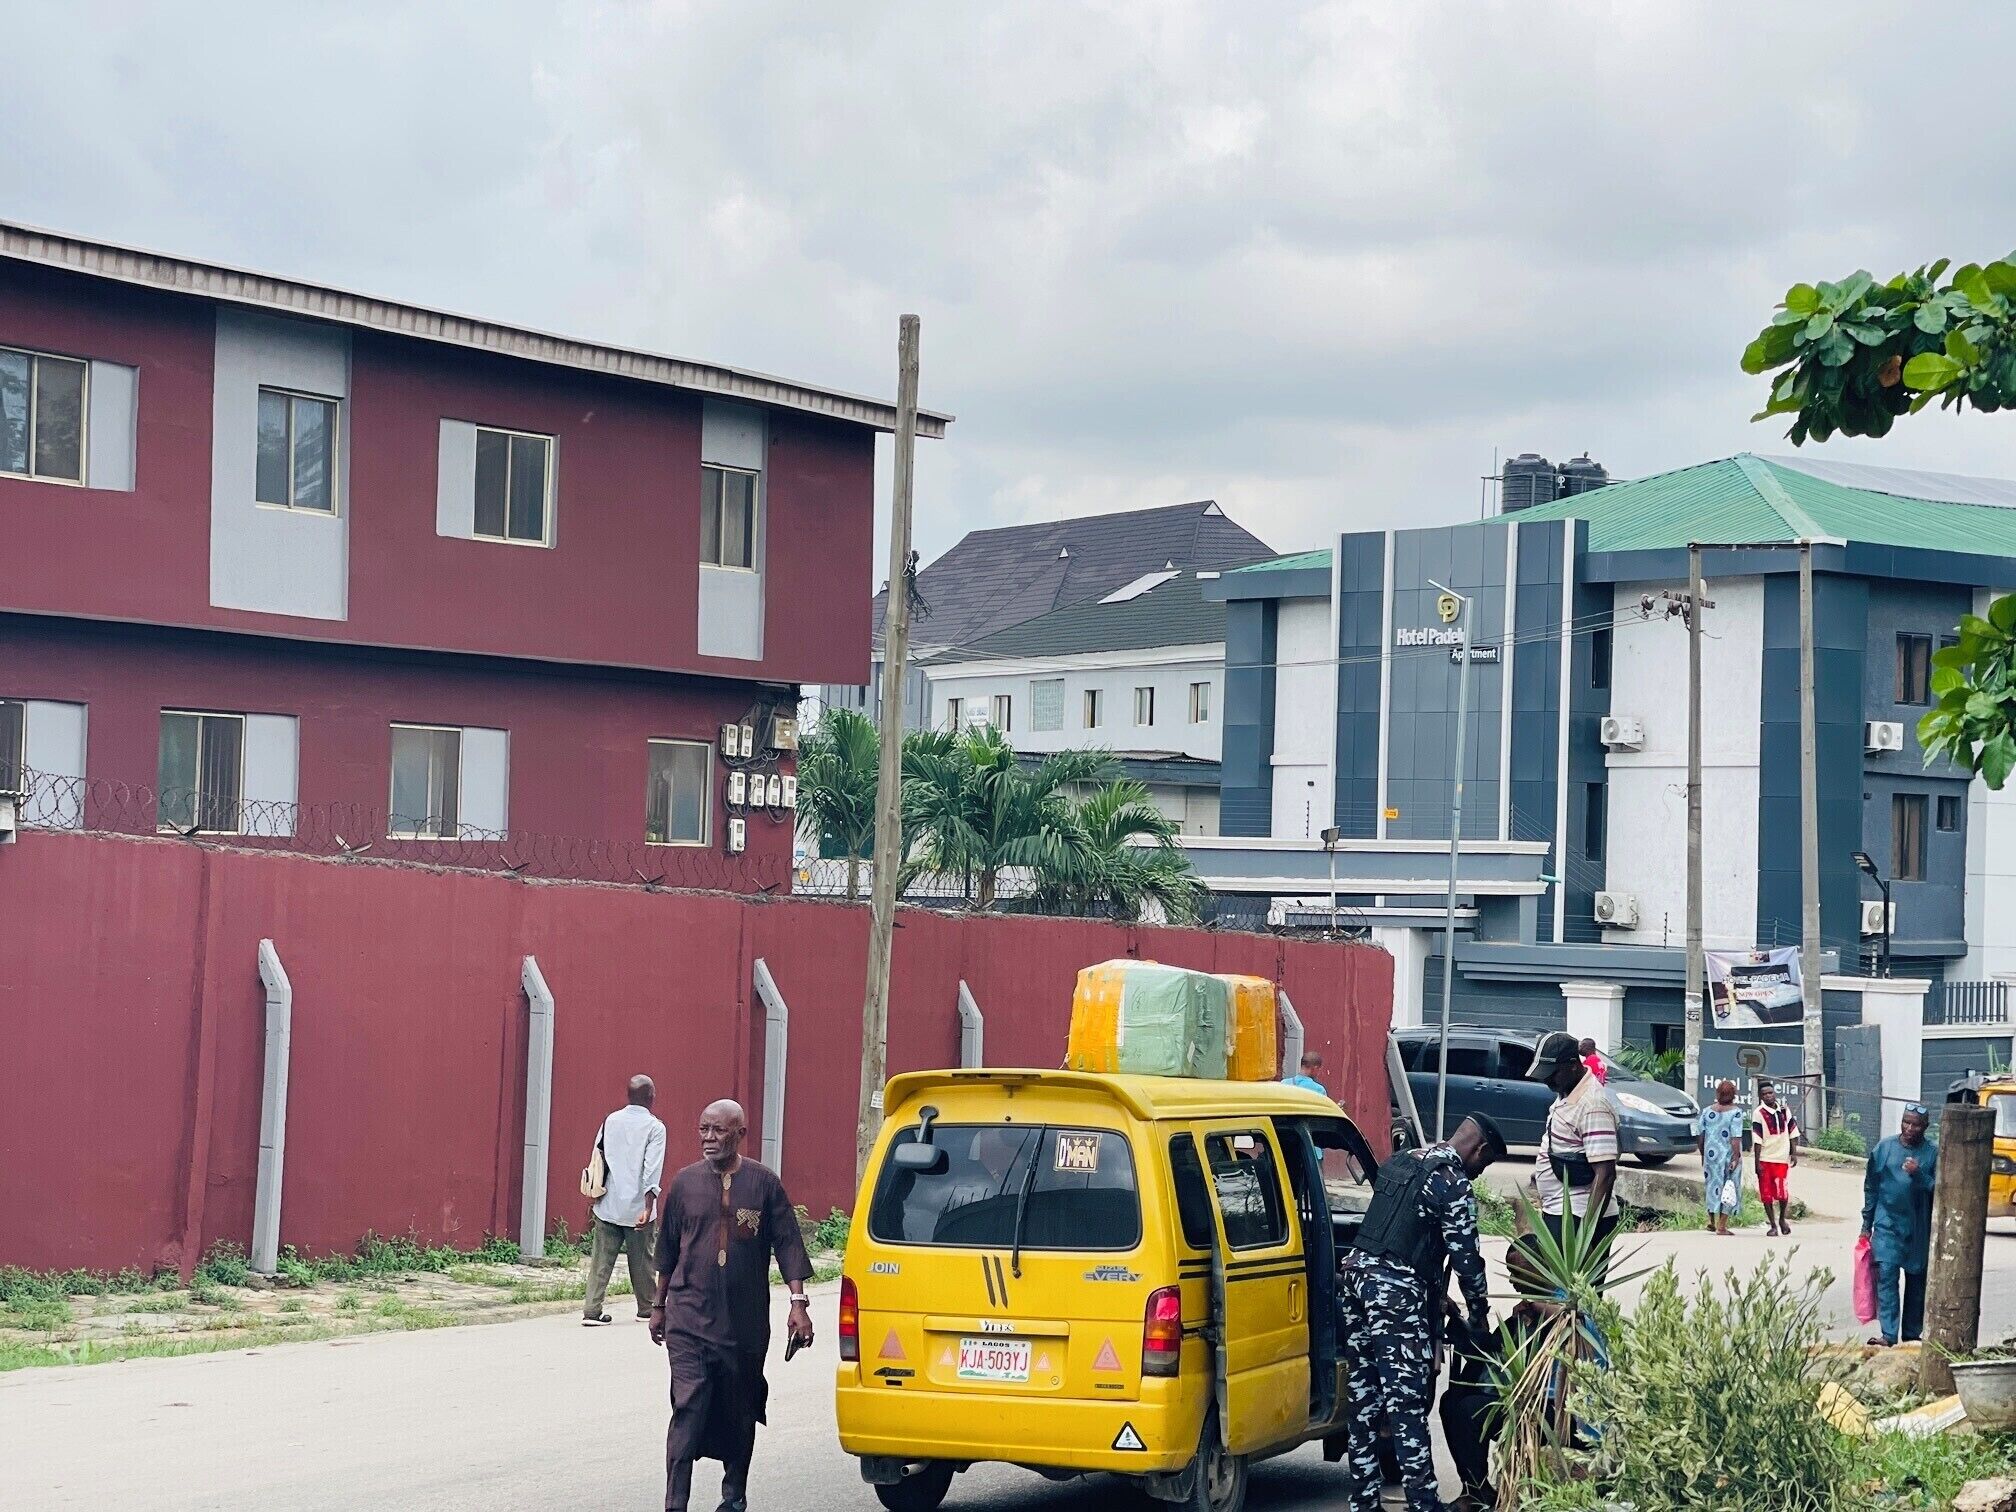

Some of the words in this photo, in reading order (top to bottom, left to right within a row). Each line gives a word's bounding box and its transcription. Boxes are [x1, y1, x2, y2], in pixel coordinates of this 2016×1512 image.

[1397, 628, 1428, 646] Hotel
[866, 1262, 900, 1274] JOIN
[1083, 1272, 1143, 1281] EVERY
[960, 1349, 1028, 1371] KJA-503YJ
